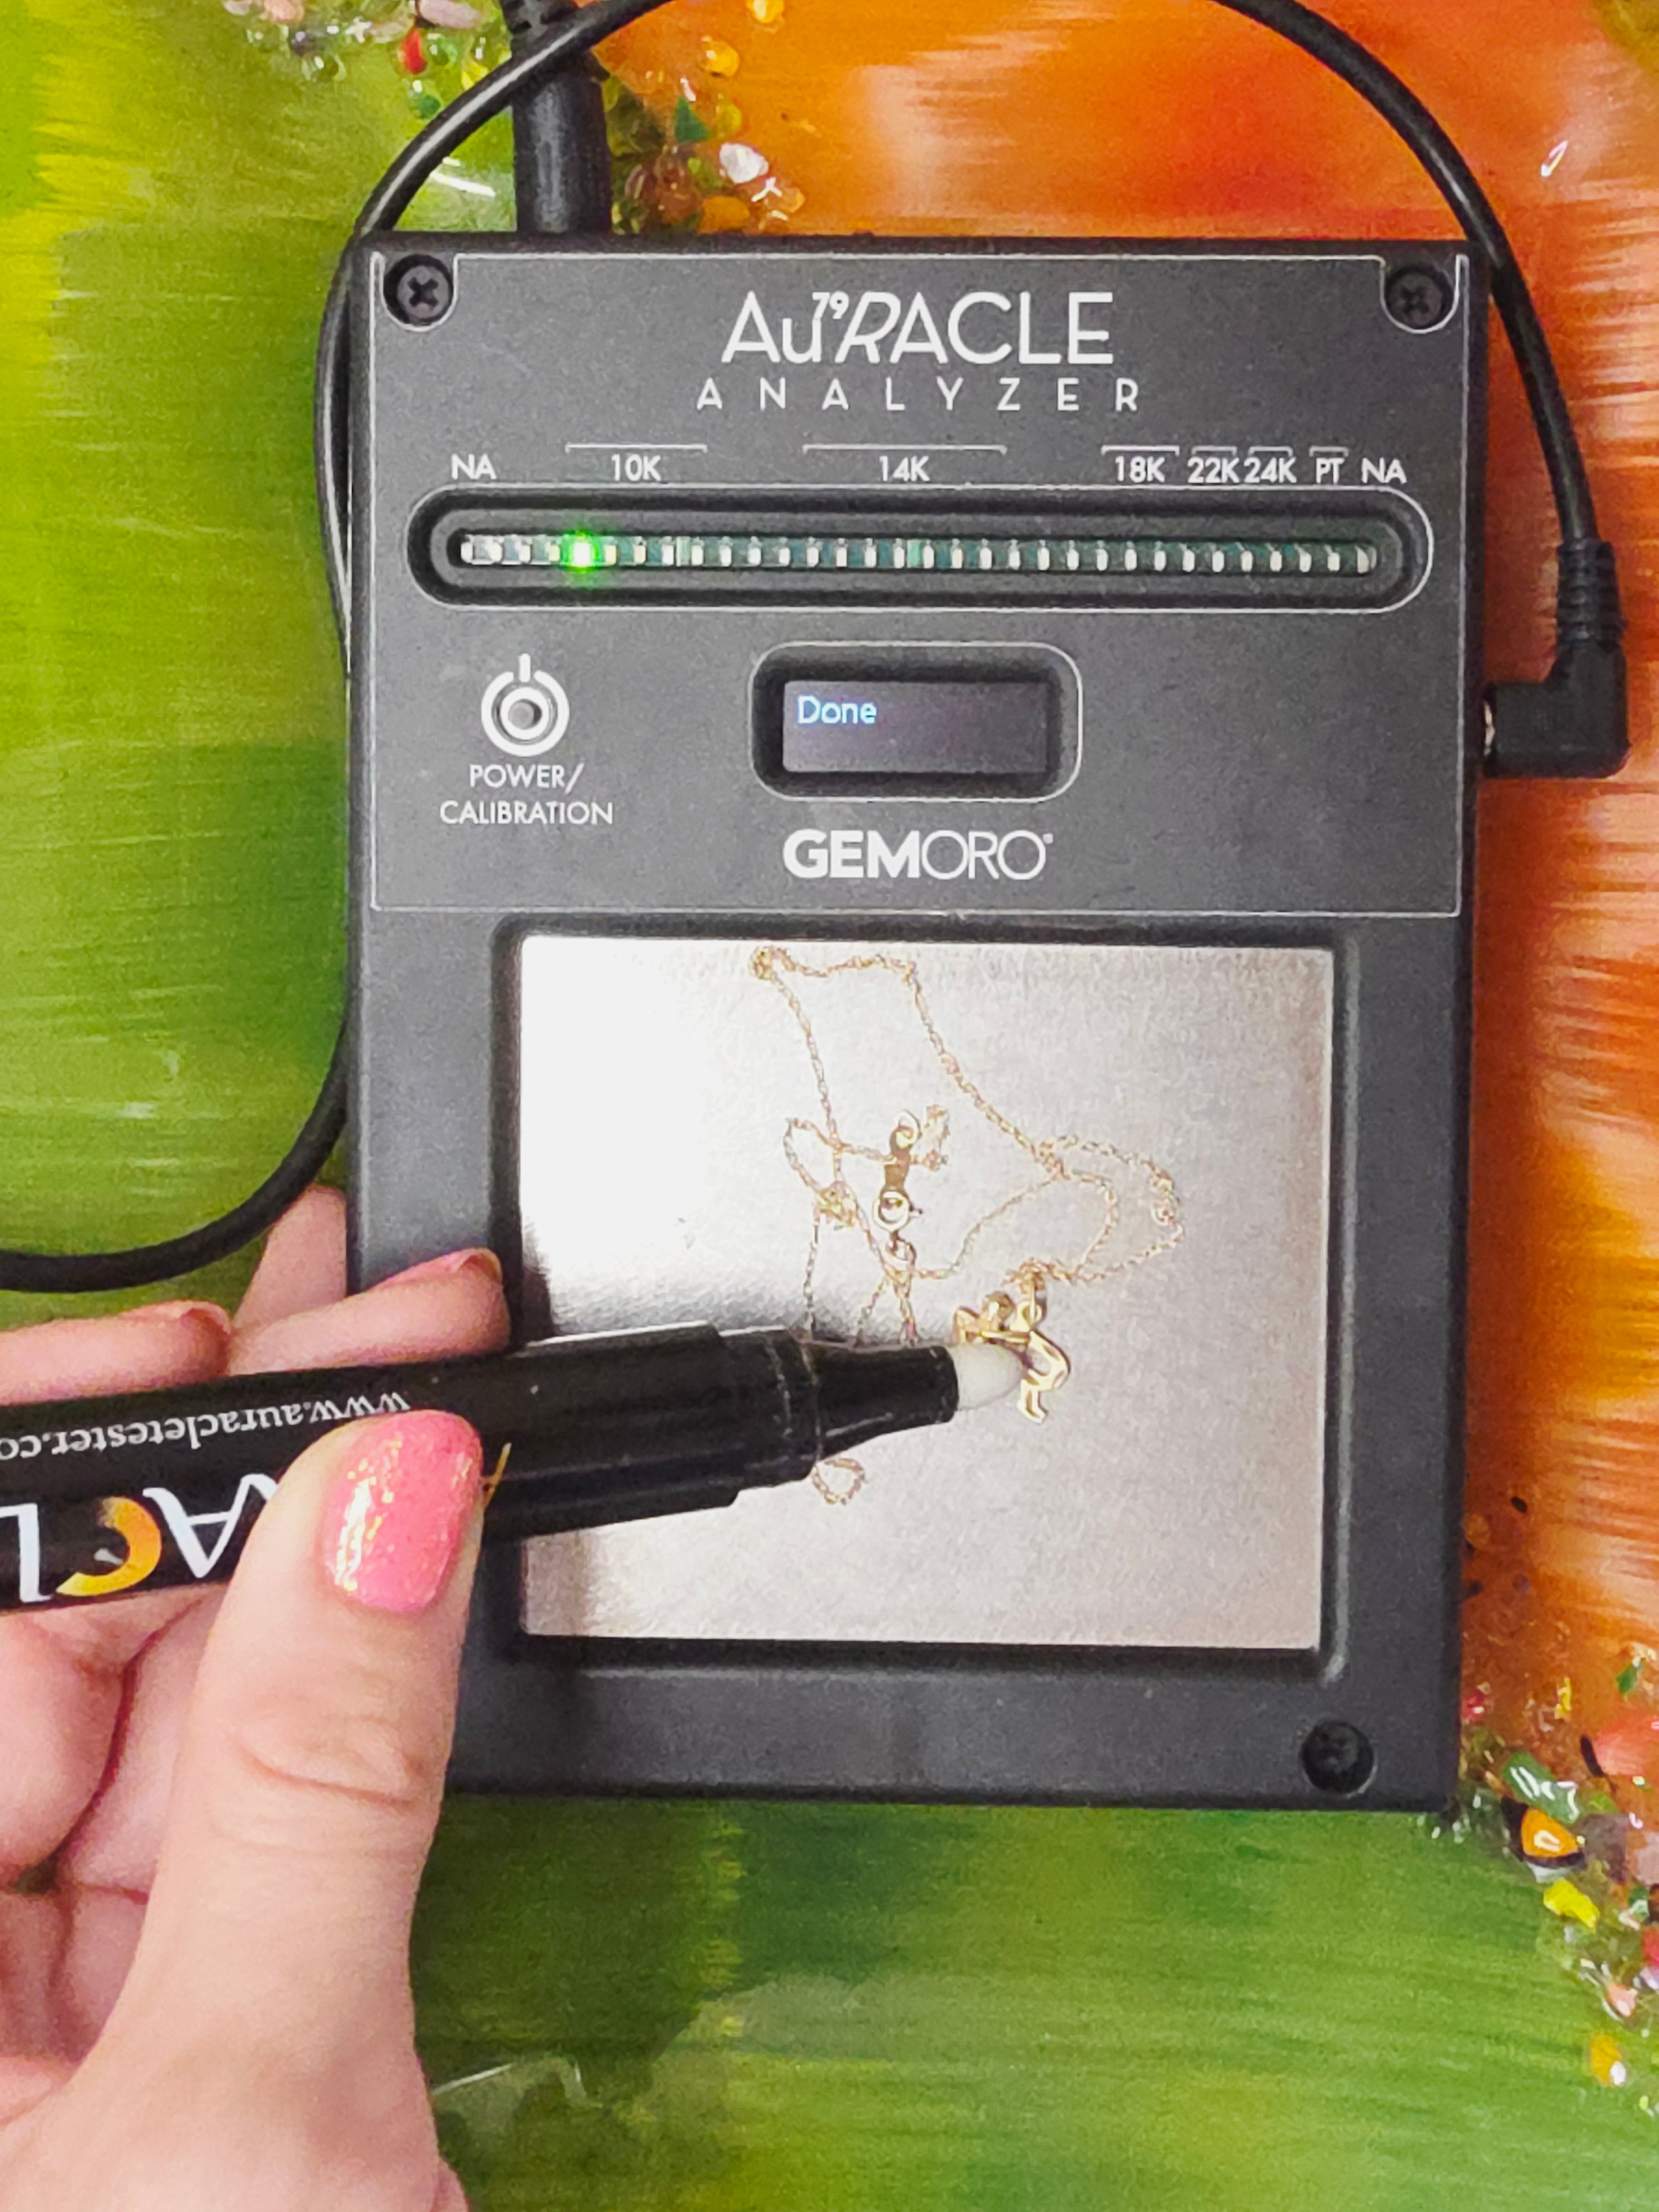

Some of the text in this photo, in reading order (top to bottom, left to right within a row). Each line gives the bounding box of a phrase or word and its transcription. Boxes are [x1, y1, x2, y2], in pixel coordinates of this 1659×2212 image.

[696, 377, 1140, 411] ANALYZER
[450, 455, 1407, 484] NA 10K 14K 18K 22K 24K PT NA
[797, 695, 878, 724] Done
[469, 762, 585, 794] POWER/
[440, 800, 613, 825] CALIBRATION
